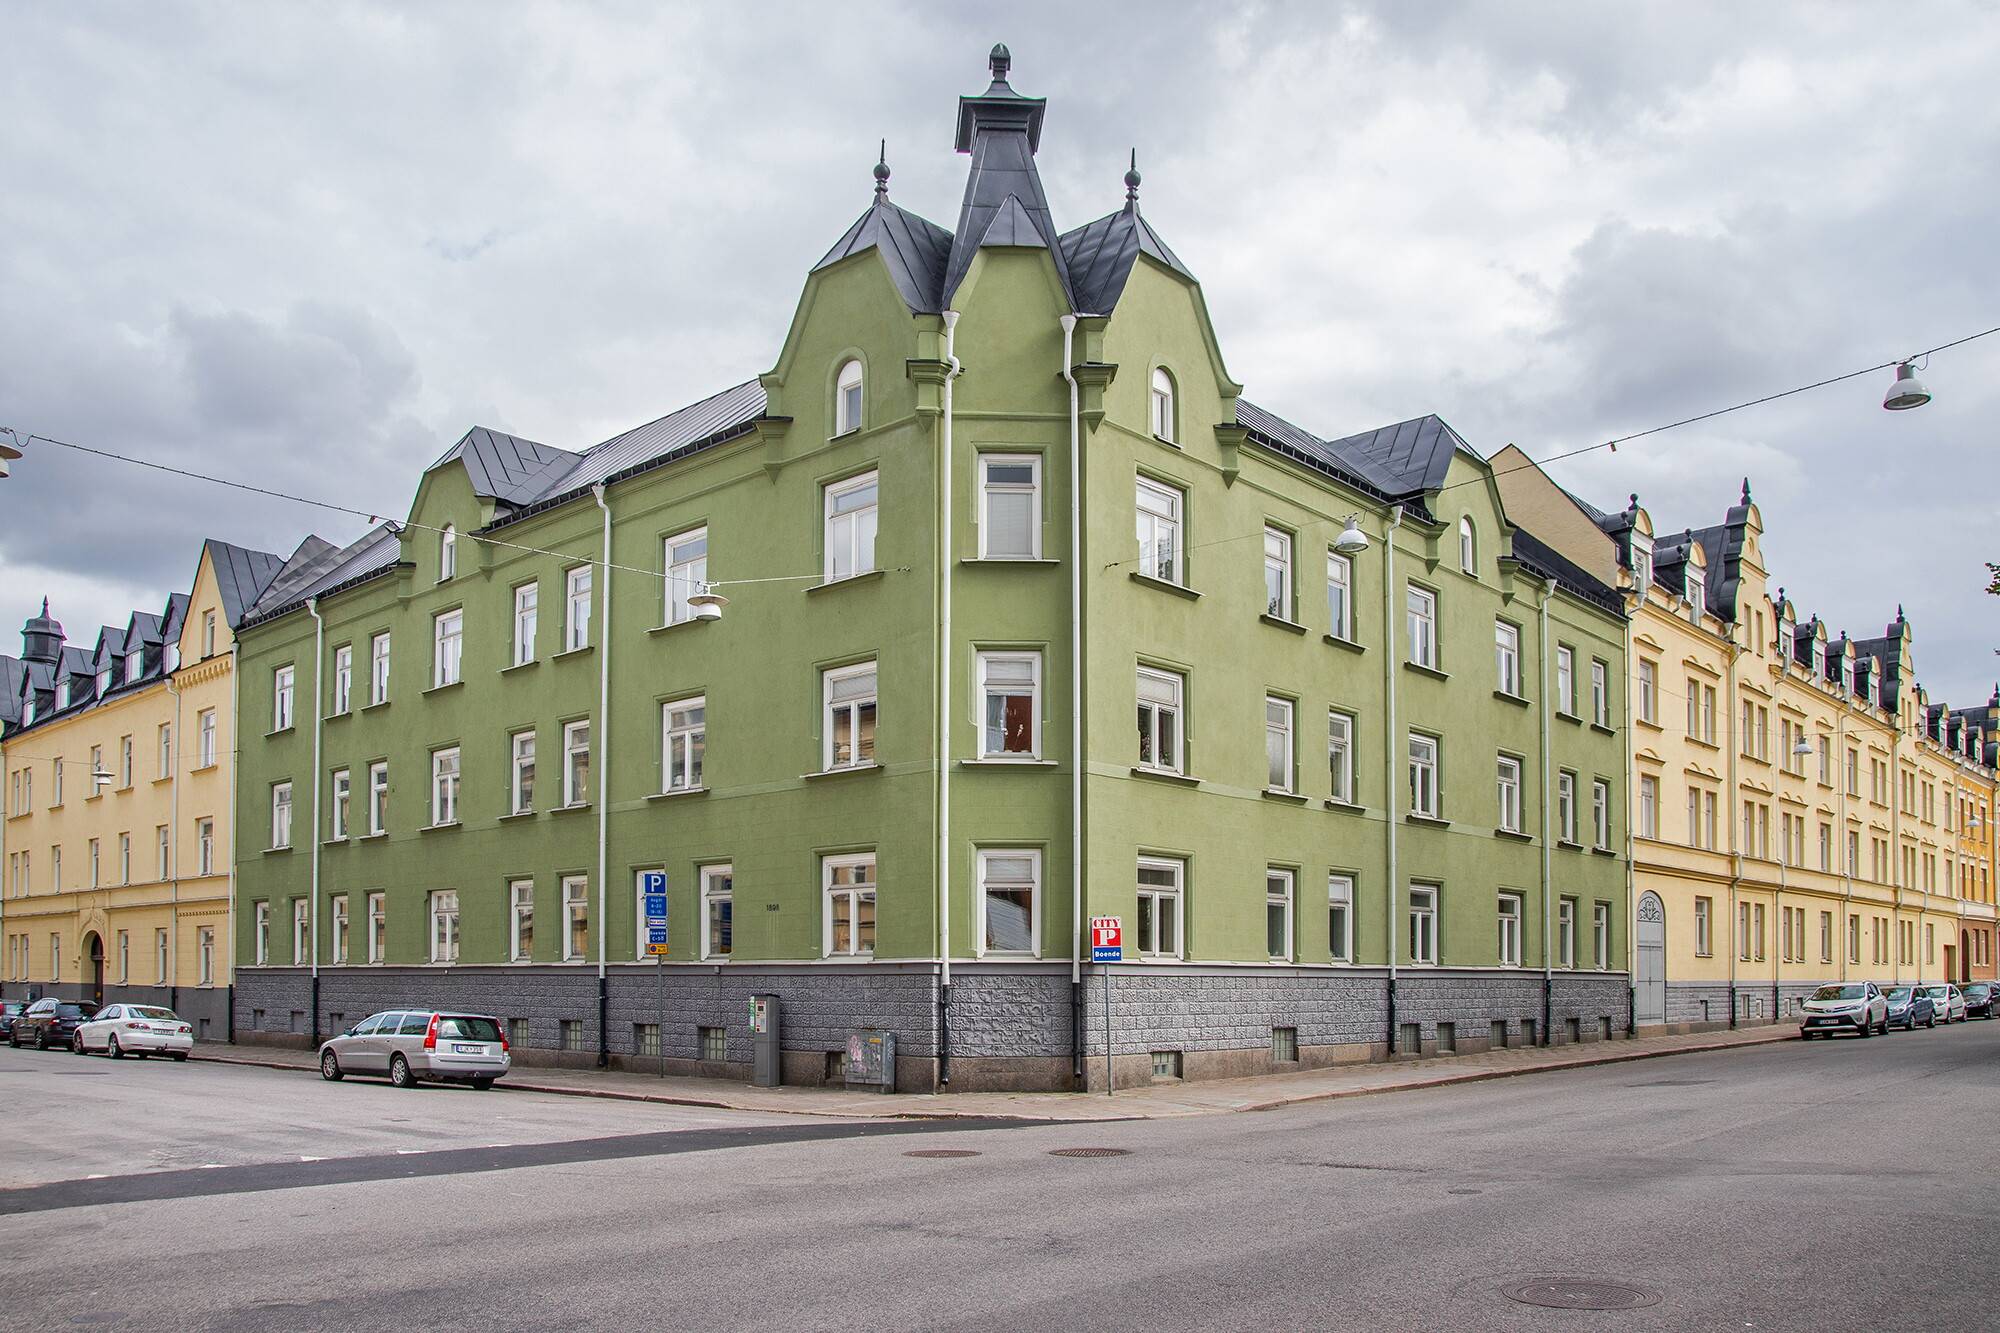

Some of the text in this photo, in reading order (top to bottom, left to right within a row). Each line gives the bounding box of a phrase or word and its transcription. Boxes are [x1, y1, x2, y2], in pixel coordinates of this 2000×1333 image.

[650, 875, 662, 893] P
[1093, 918, 1120, 928] CITY
[1099, 929, 1116, 946] P
